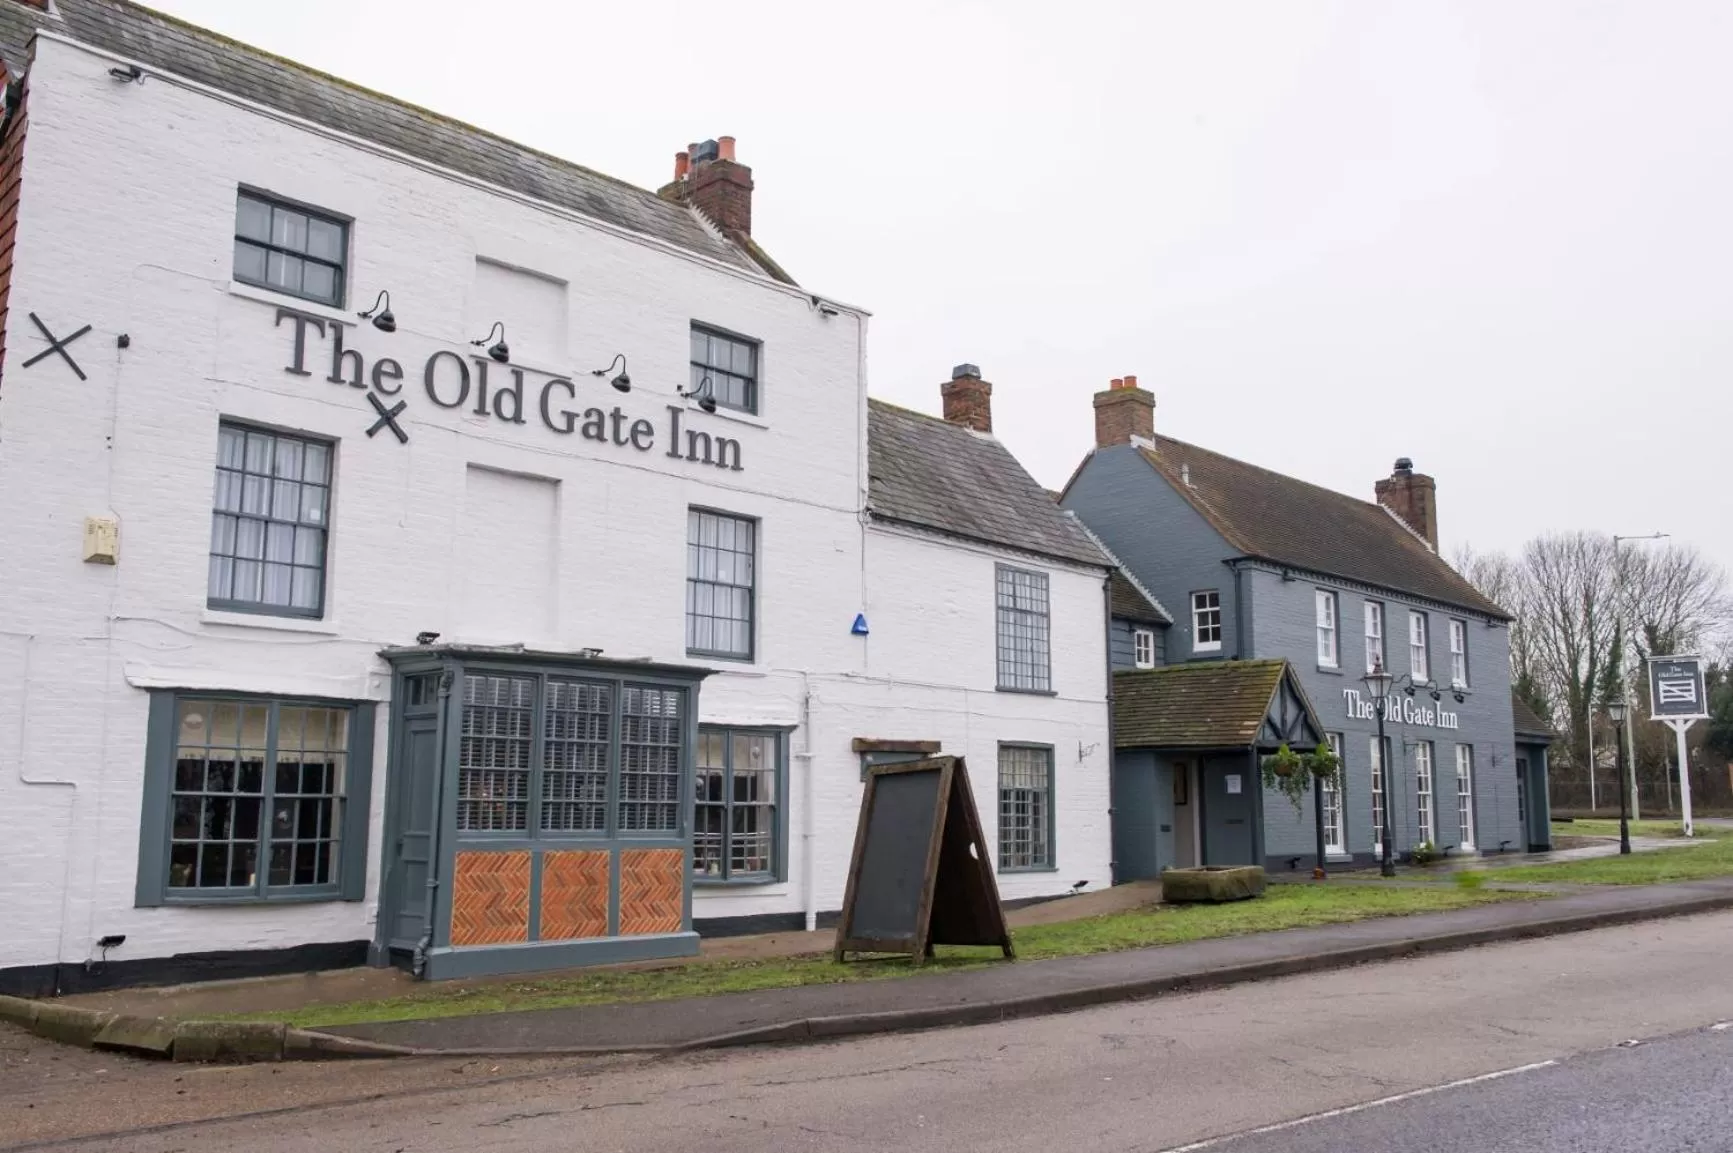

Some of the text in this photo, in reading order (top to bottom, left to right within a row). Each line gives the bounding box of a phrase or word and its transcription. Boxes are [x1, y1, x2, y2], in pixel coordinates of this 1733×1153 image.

[275, 307, 744, 471] The Old Gate Inn
[1343, 688, 1374, 720] The
[1404, 697, 1434, 726] Gate
[1435, 701, 1459, 729] Inn
